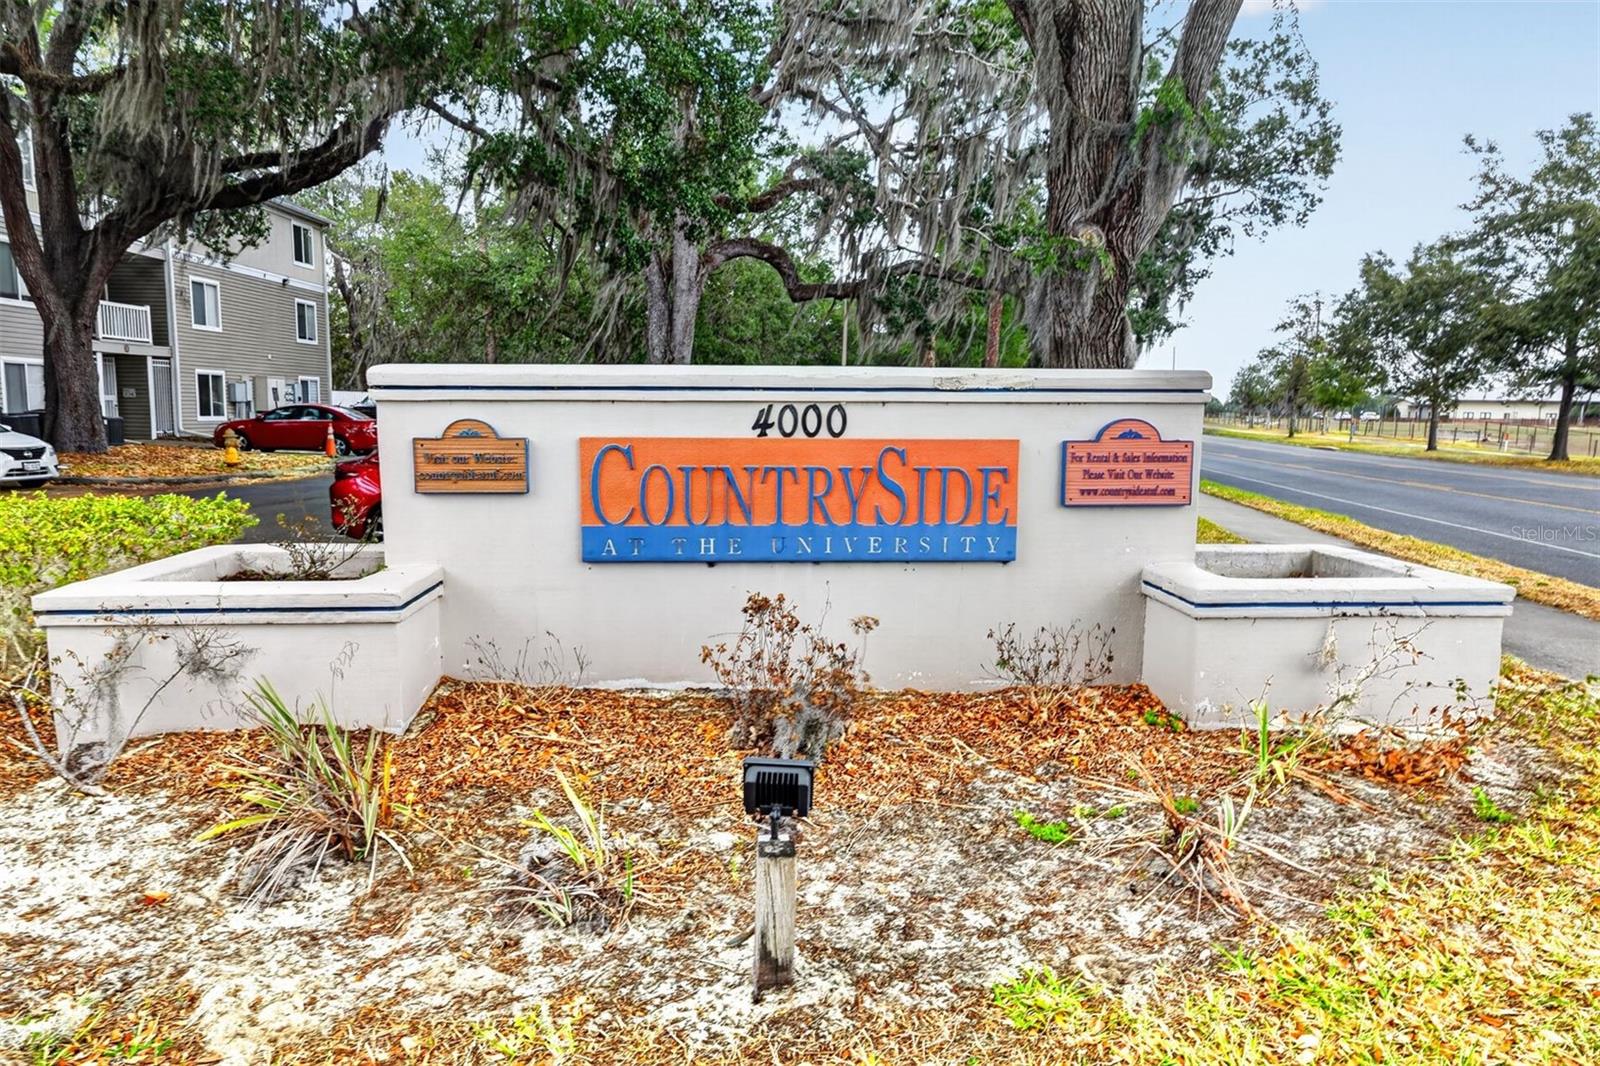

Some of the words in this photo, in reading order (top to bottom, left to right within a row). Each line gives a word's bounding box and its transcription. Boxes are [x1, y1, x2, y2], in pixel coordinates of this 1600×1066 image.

[752, 403, 847, 438] 4000
[1070, 452, 1084, 463] For
[1086, 452, 1110, 463] Rental
[1113, 452, 1119, 463] &
[1122, 452, 1141, 463] Sales
[1143, 451, 1187, 463] Information
[1082, 469, 1105, 480] Please
[1107, 468, 1125, 480] Visit
[1127, 469, 1143, 480] Our
[1145, 468, 1175, 480] Website
[601, 539, 645, 556] AT
[671, 538, 741, 556] THE
[771, 536, 1001, 556] UNIVERSITY
